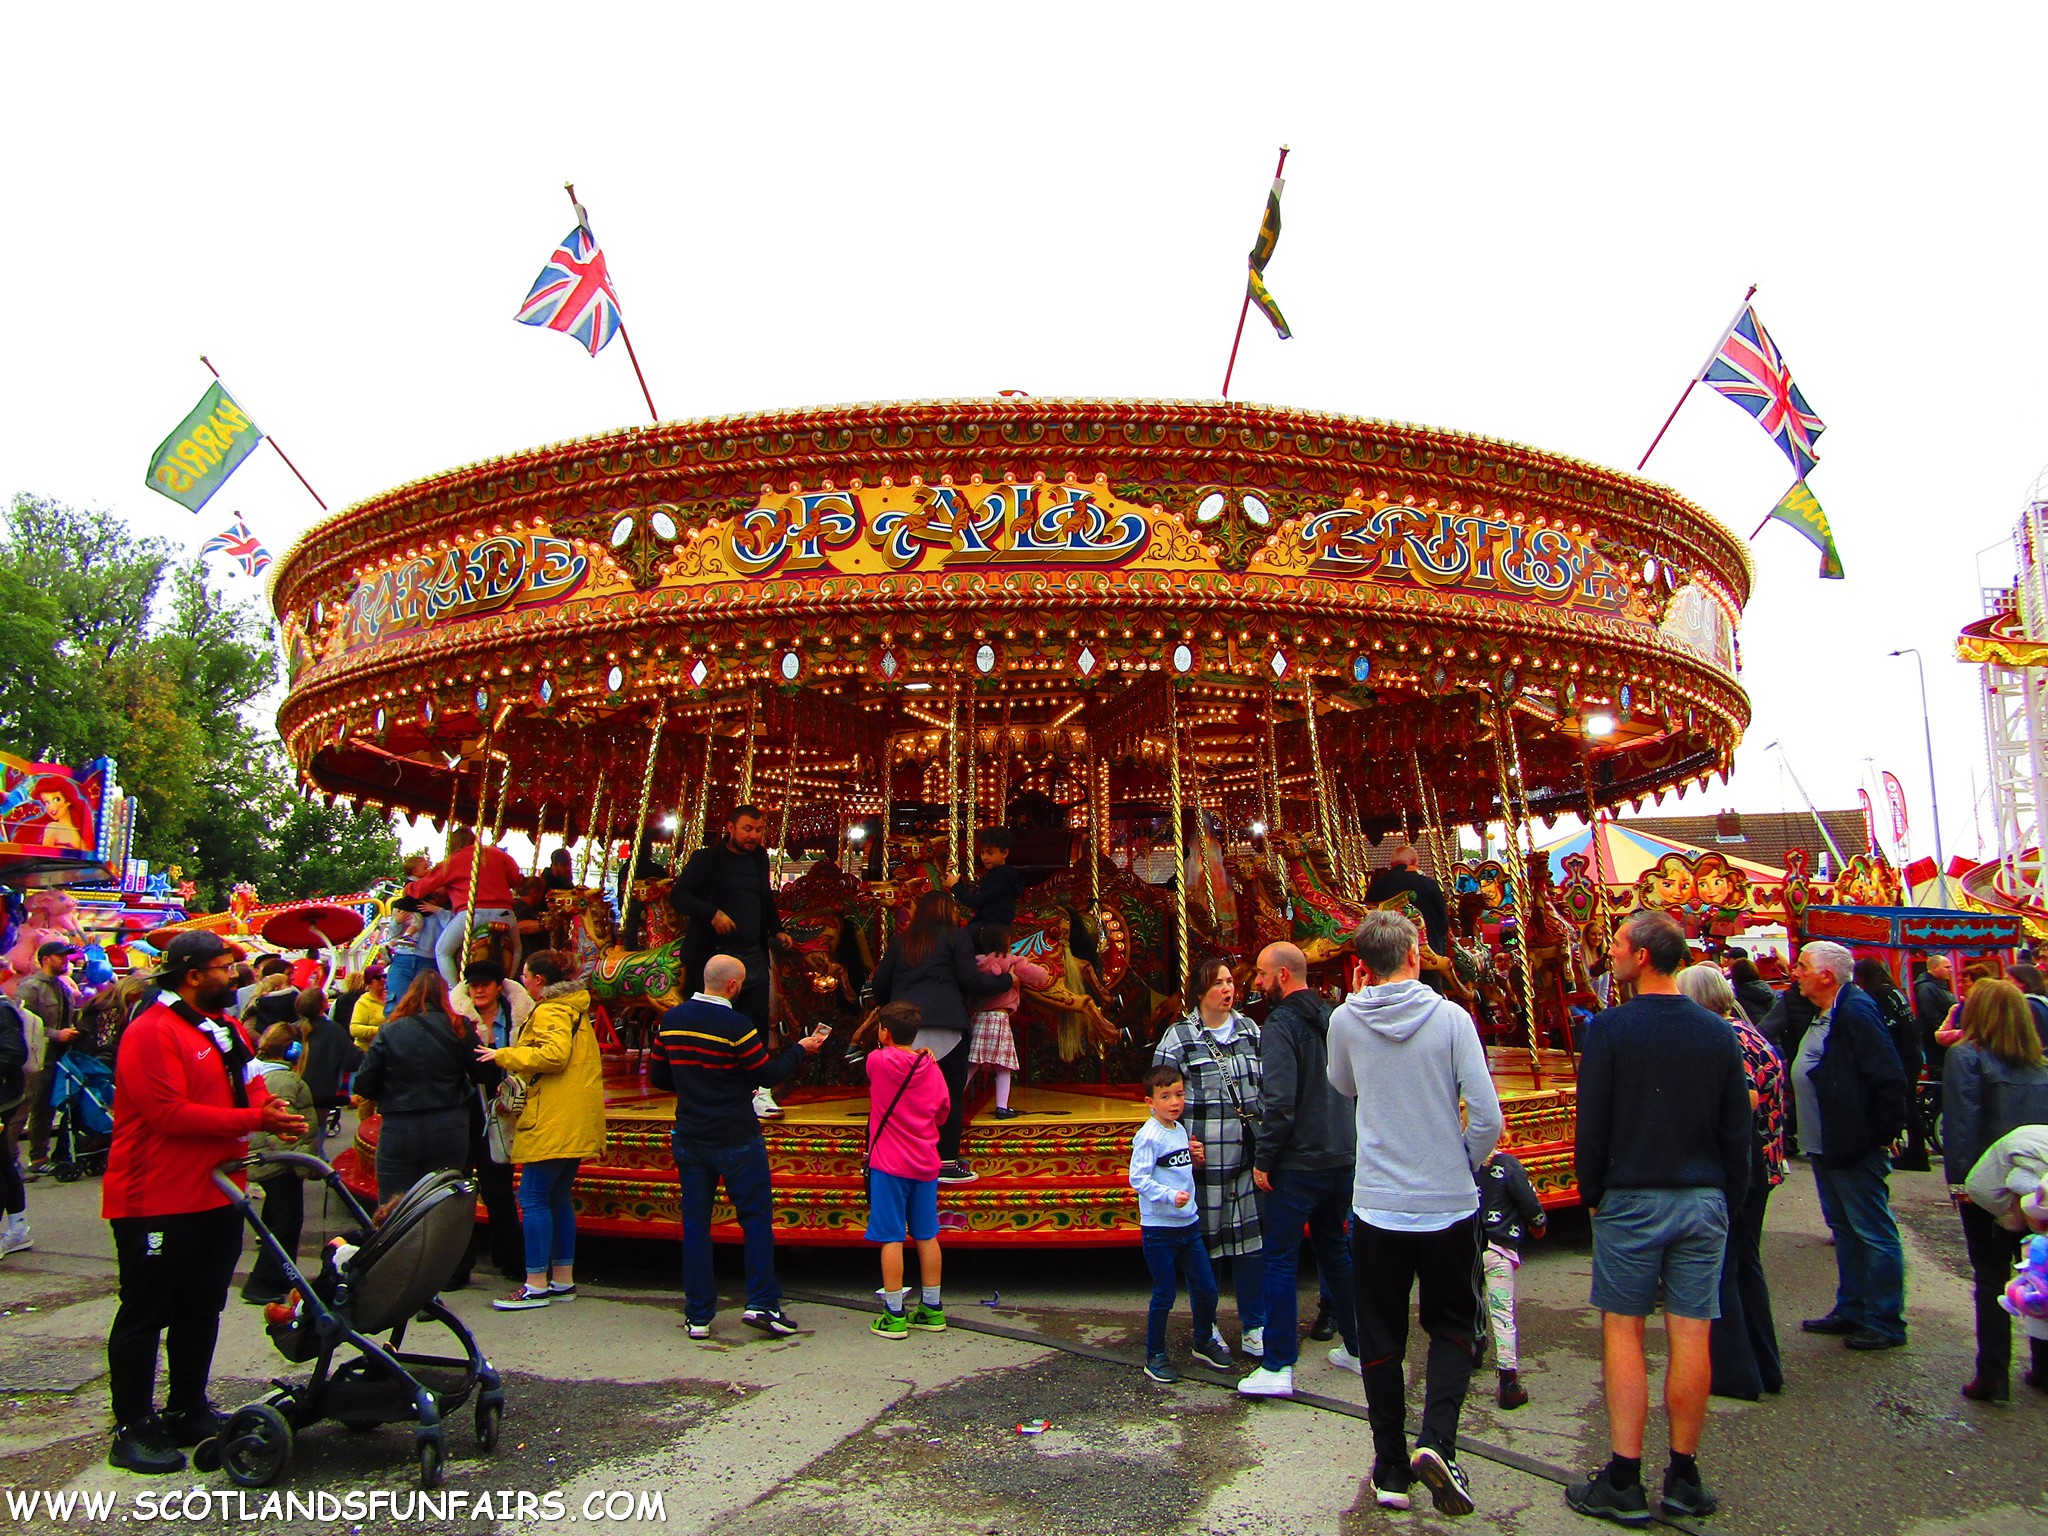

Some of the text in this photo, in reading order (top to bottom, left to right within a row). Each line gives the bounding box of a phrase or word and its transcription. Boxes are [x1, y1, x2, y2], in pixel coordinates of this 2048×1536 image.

[345, 484, 1628, 640] PARADE OF ALL BRITISH
[1168, 1150, 1192, 1166] adid
